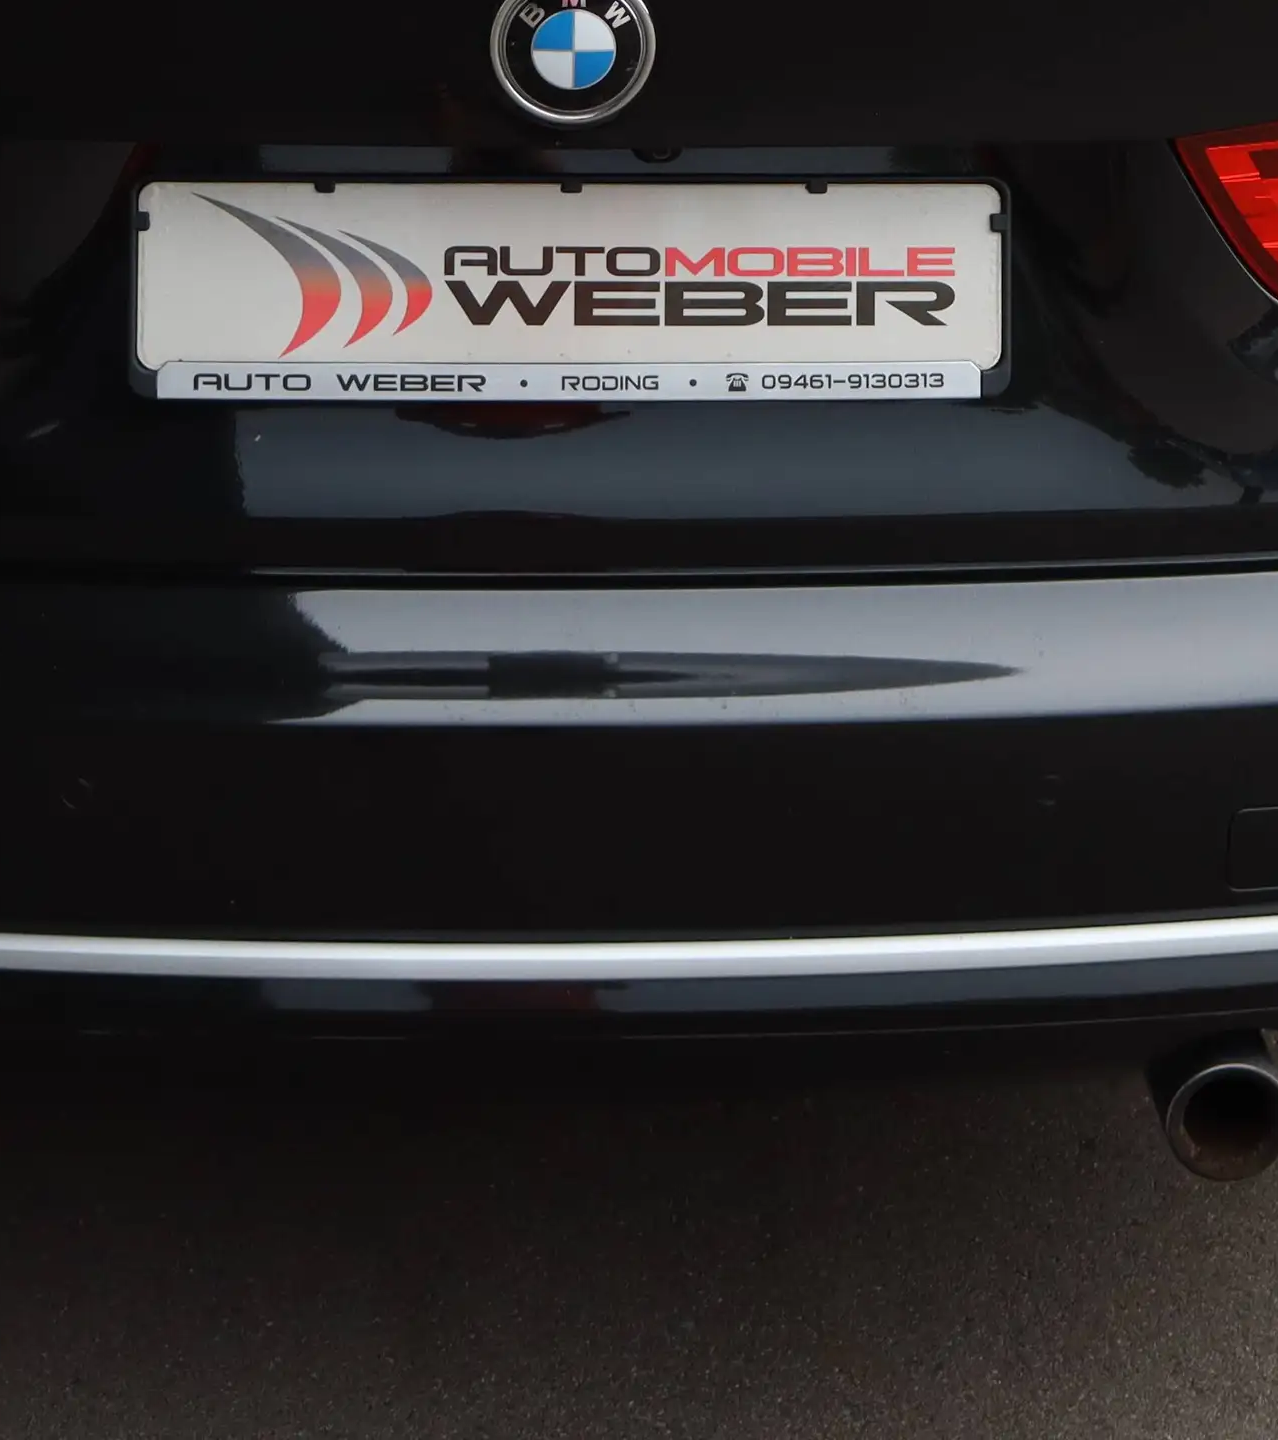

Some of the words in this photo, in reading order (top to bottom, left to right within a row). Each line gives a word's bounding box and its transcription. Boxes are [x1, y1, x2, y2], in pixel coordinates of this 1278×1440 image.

[443, 245, 956, 277] AUTOMOBILE
[443, 280, 956, 326] WEBER
[193, 373, 312, 392] AUTO
[336, 373, 487, 393] WEBER
[560, 374, 660, 392] RODING
[761, 373, 945, 390] 09461-9130313
